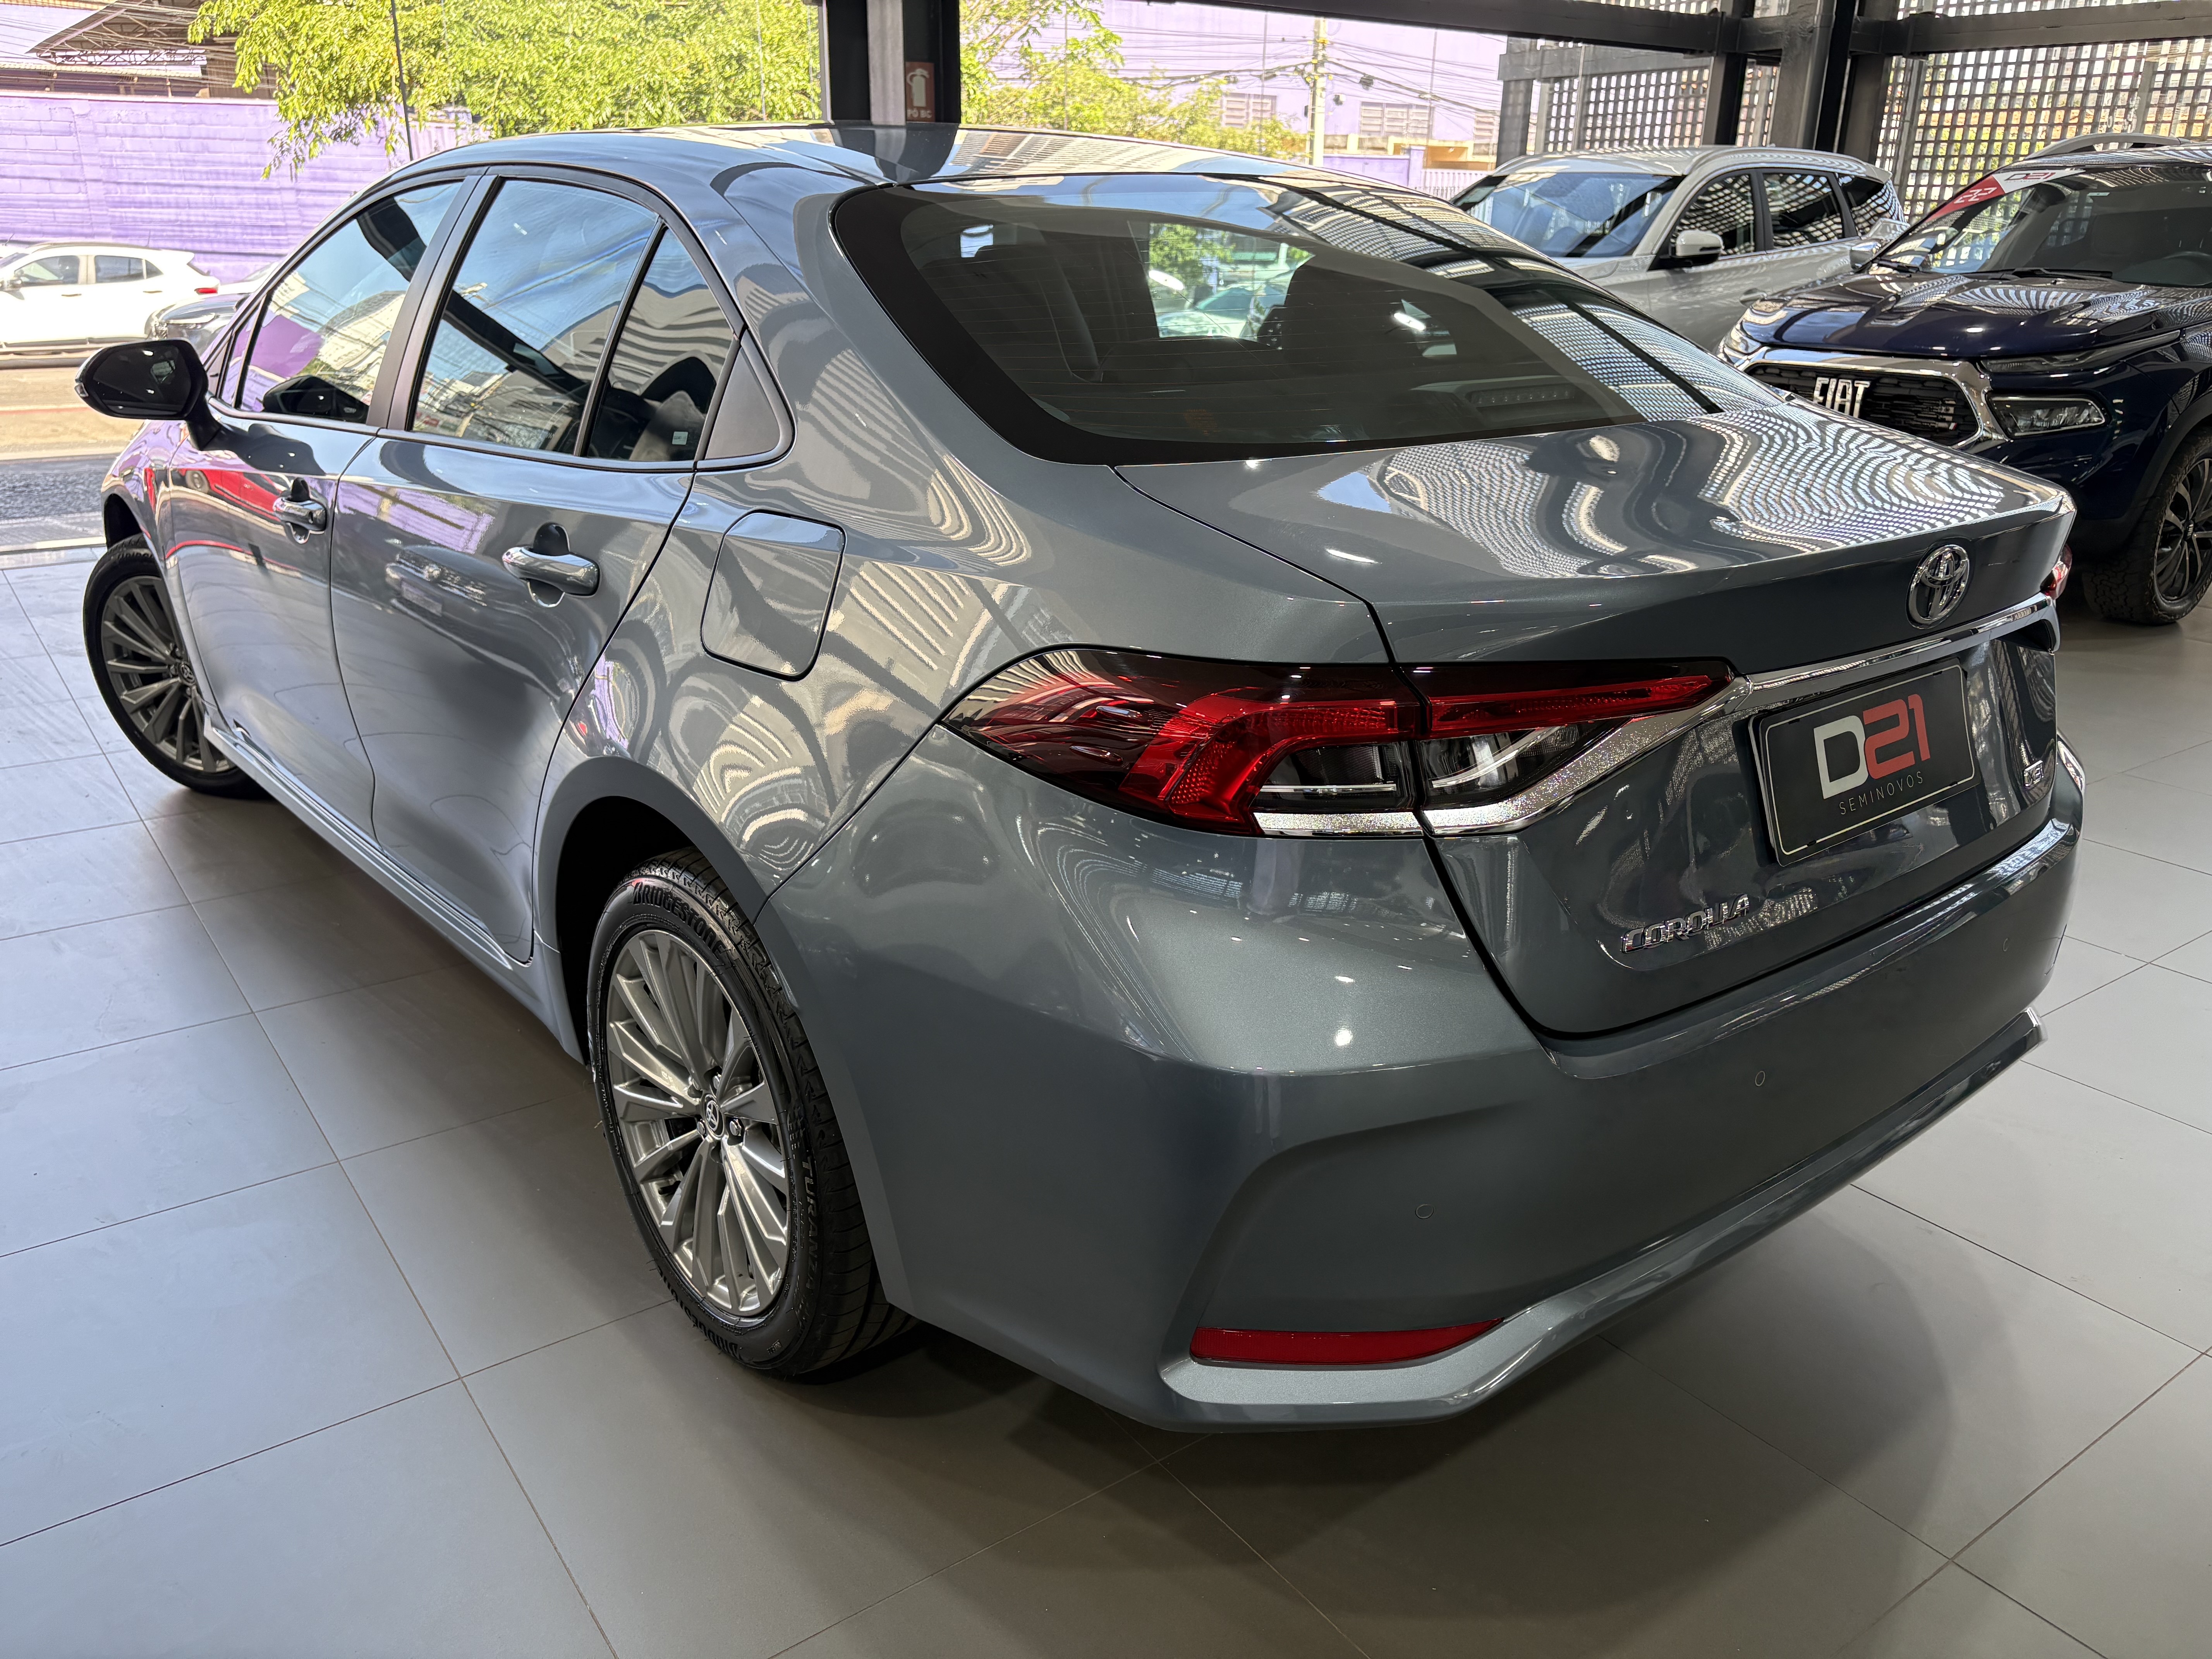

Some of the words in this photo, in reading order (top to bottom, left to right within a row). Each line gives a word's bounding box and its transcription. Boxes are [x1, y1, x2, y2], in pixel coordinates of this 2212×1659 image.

[1813, 377, 1870, 418] FIAT
[1814, 694, 1930, 800] D21
[1839, 771, 1923, 815] SEMINOVOS
[632, 881, 727, 960] BRIDGESTONE
[1621, 894, 1750, 953] COROLLA
[802, 1156, 818, 1289] TURANZA
